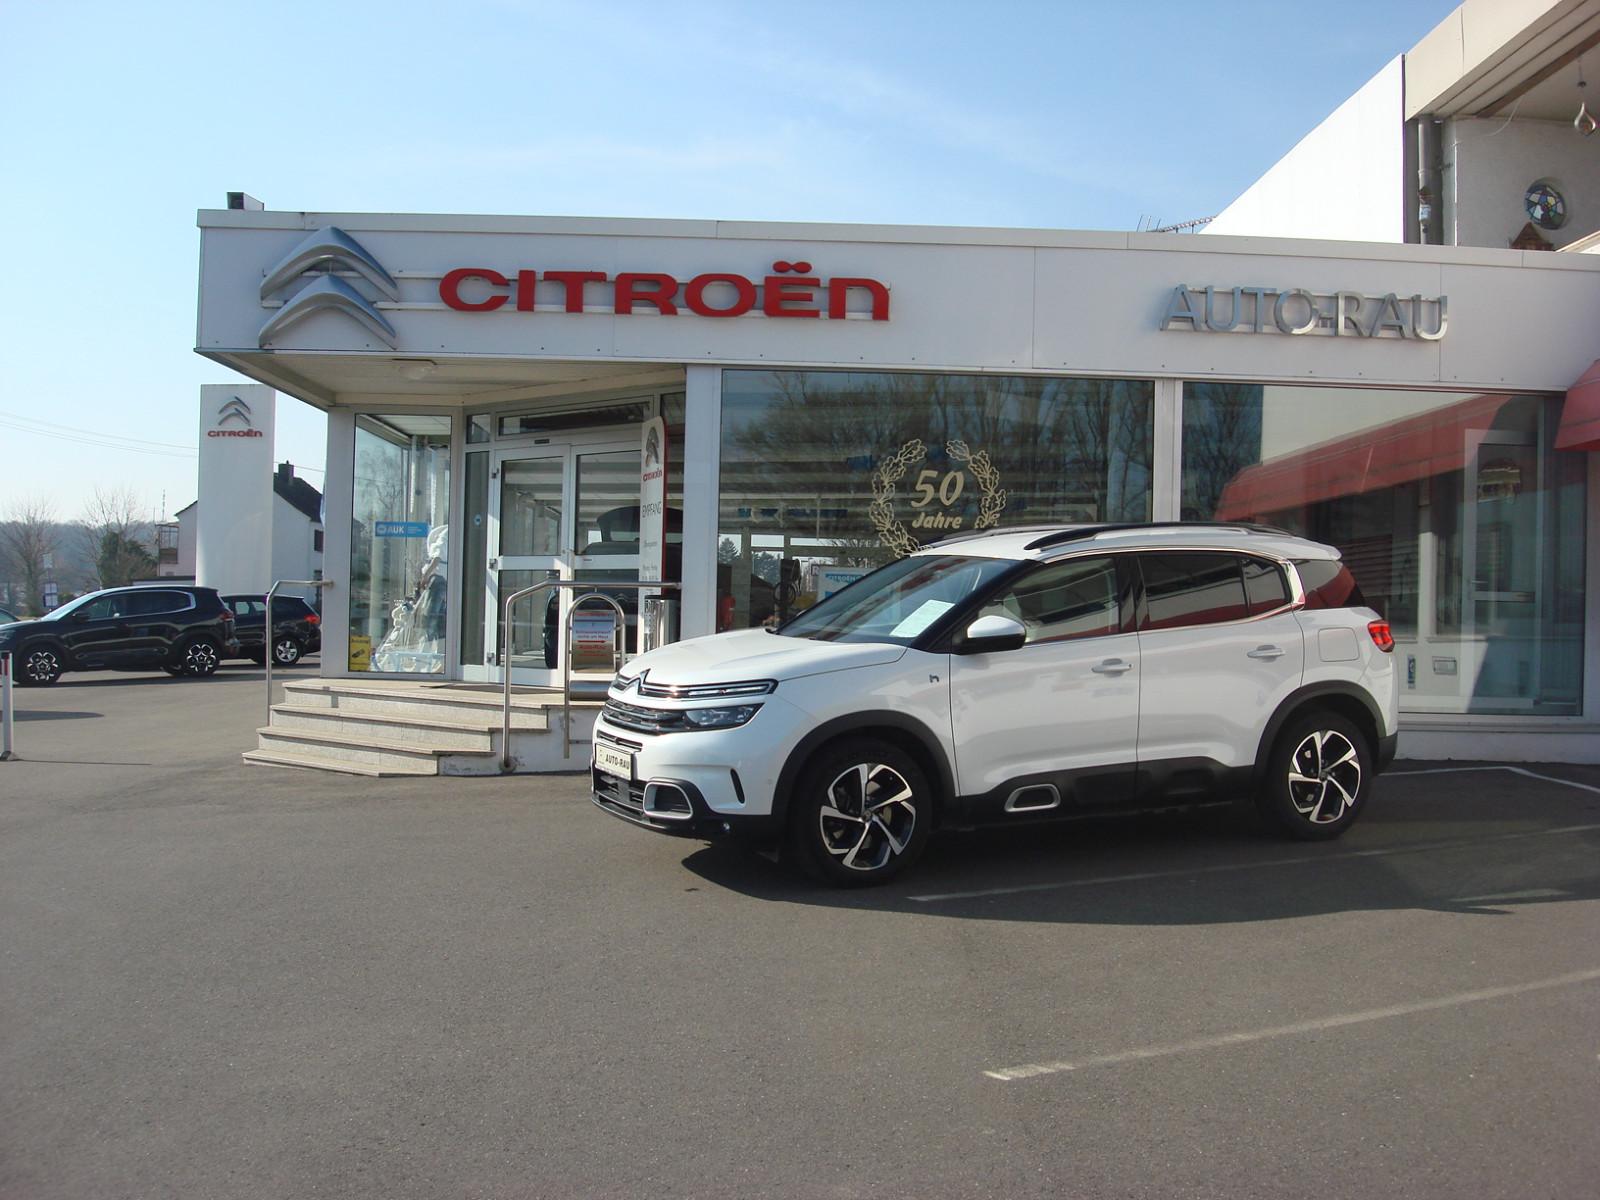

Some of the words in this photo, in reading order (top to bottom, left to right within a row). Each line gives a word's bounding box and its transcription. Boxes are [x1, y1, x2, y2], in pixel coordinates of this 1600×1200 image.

[1160, 284, 1449, 342] AUTO-RAU
[910, 470, 965, 508] 50
[911, 512, 963, 529] Jahre
